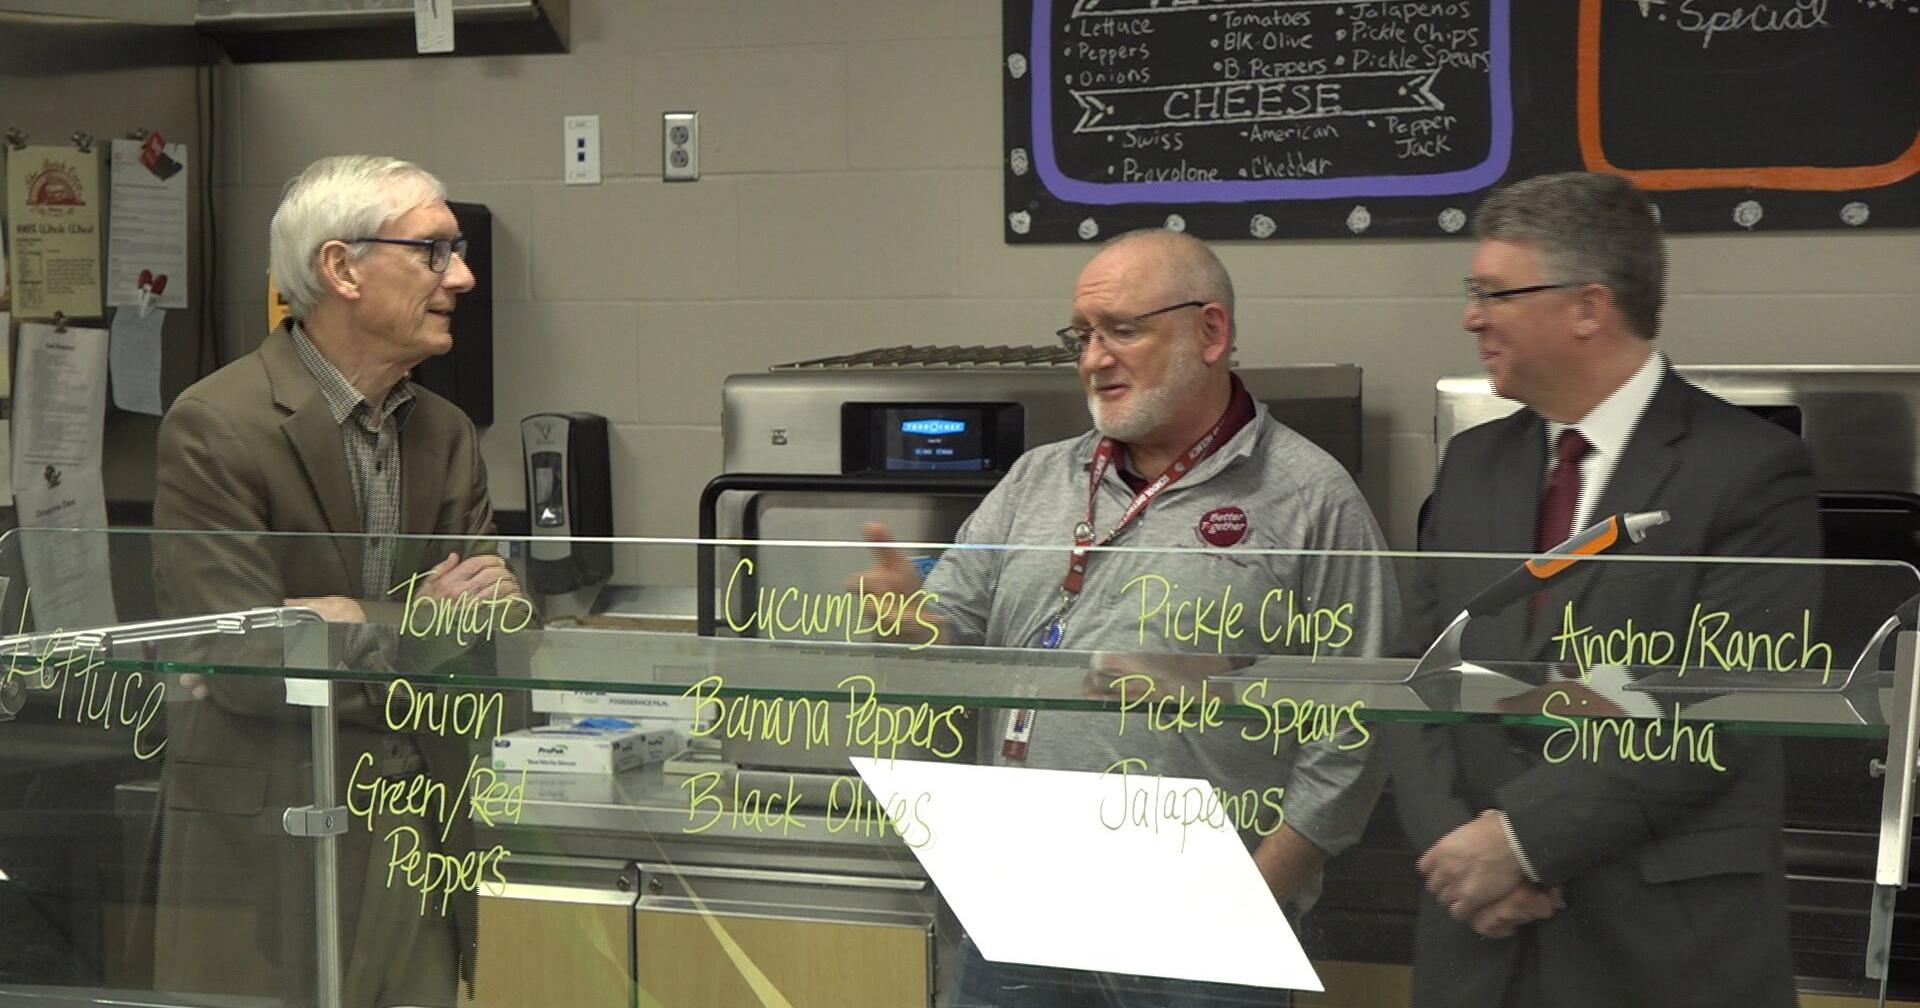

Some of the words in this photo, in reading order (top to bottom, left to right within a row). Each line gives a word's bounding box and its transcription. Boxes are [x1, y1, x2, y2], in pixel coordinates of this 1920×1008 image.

[1080, 18, 1154, 37] Lettuce
[1223, 9, 1312, 29] Tomatoes
[1350, 0, 1471, 24] Jalapenos
[1677, 0, 1831, 48] Special
[1262, 31, 1313, 50] Olive
[1352, 21, 1407, 43] Pickle
[1413, 23, 1479, 50] Chips
[1079, 42, 1150, 65] Peppers
[1248, 58, 1327, 78] Peppers
[1353, 46, 1418, 71] Pickle
[1422, 44, 1493, 73] Spears
[1080, 67, 1150, 87] Onions
[1163, 82, 1342, 120] CHEESE
[1122, 130, 1184, 151] Swiss
[1249, 122, 1340, 143] American
[1386, 115, 1457, 137] Pepper
[1395, 135, 1452, 158] Jack
[1122, 156, 1223, 183] Provolone
[1251, 150, 1333, 178] Cheddar
[387, 570, 532, 645] Tomato
[725, 558, 939, 650] Cucumbers
[1121, 574, 1244, 654] Pickle
[1259, 588, 1353, 663] Chips
[1552, 600, 1832, 684] Ancho/Ranch
[7, 587, 168, 760] Lettuce
[385, 679, 503, 740] Onion
[680, 676, 829, 750] Banana
[838, 675, 964, 770] Peppers
[1109, 674, 1223, 736] Pickle
[1241, 678, 1370, 755] Spears
[1542, 691, 1726, 772] Siracha
[347, 752, 529, 843] Green/Red
[681, 771, 806, 836] Black
[826, 775, 934, 848] Olives
[1100, 758, 1285, 853] Jalapenos
[385, 826, 512, 916] Peppers
